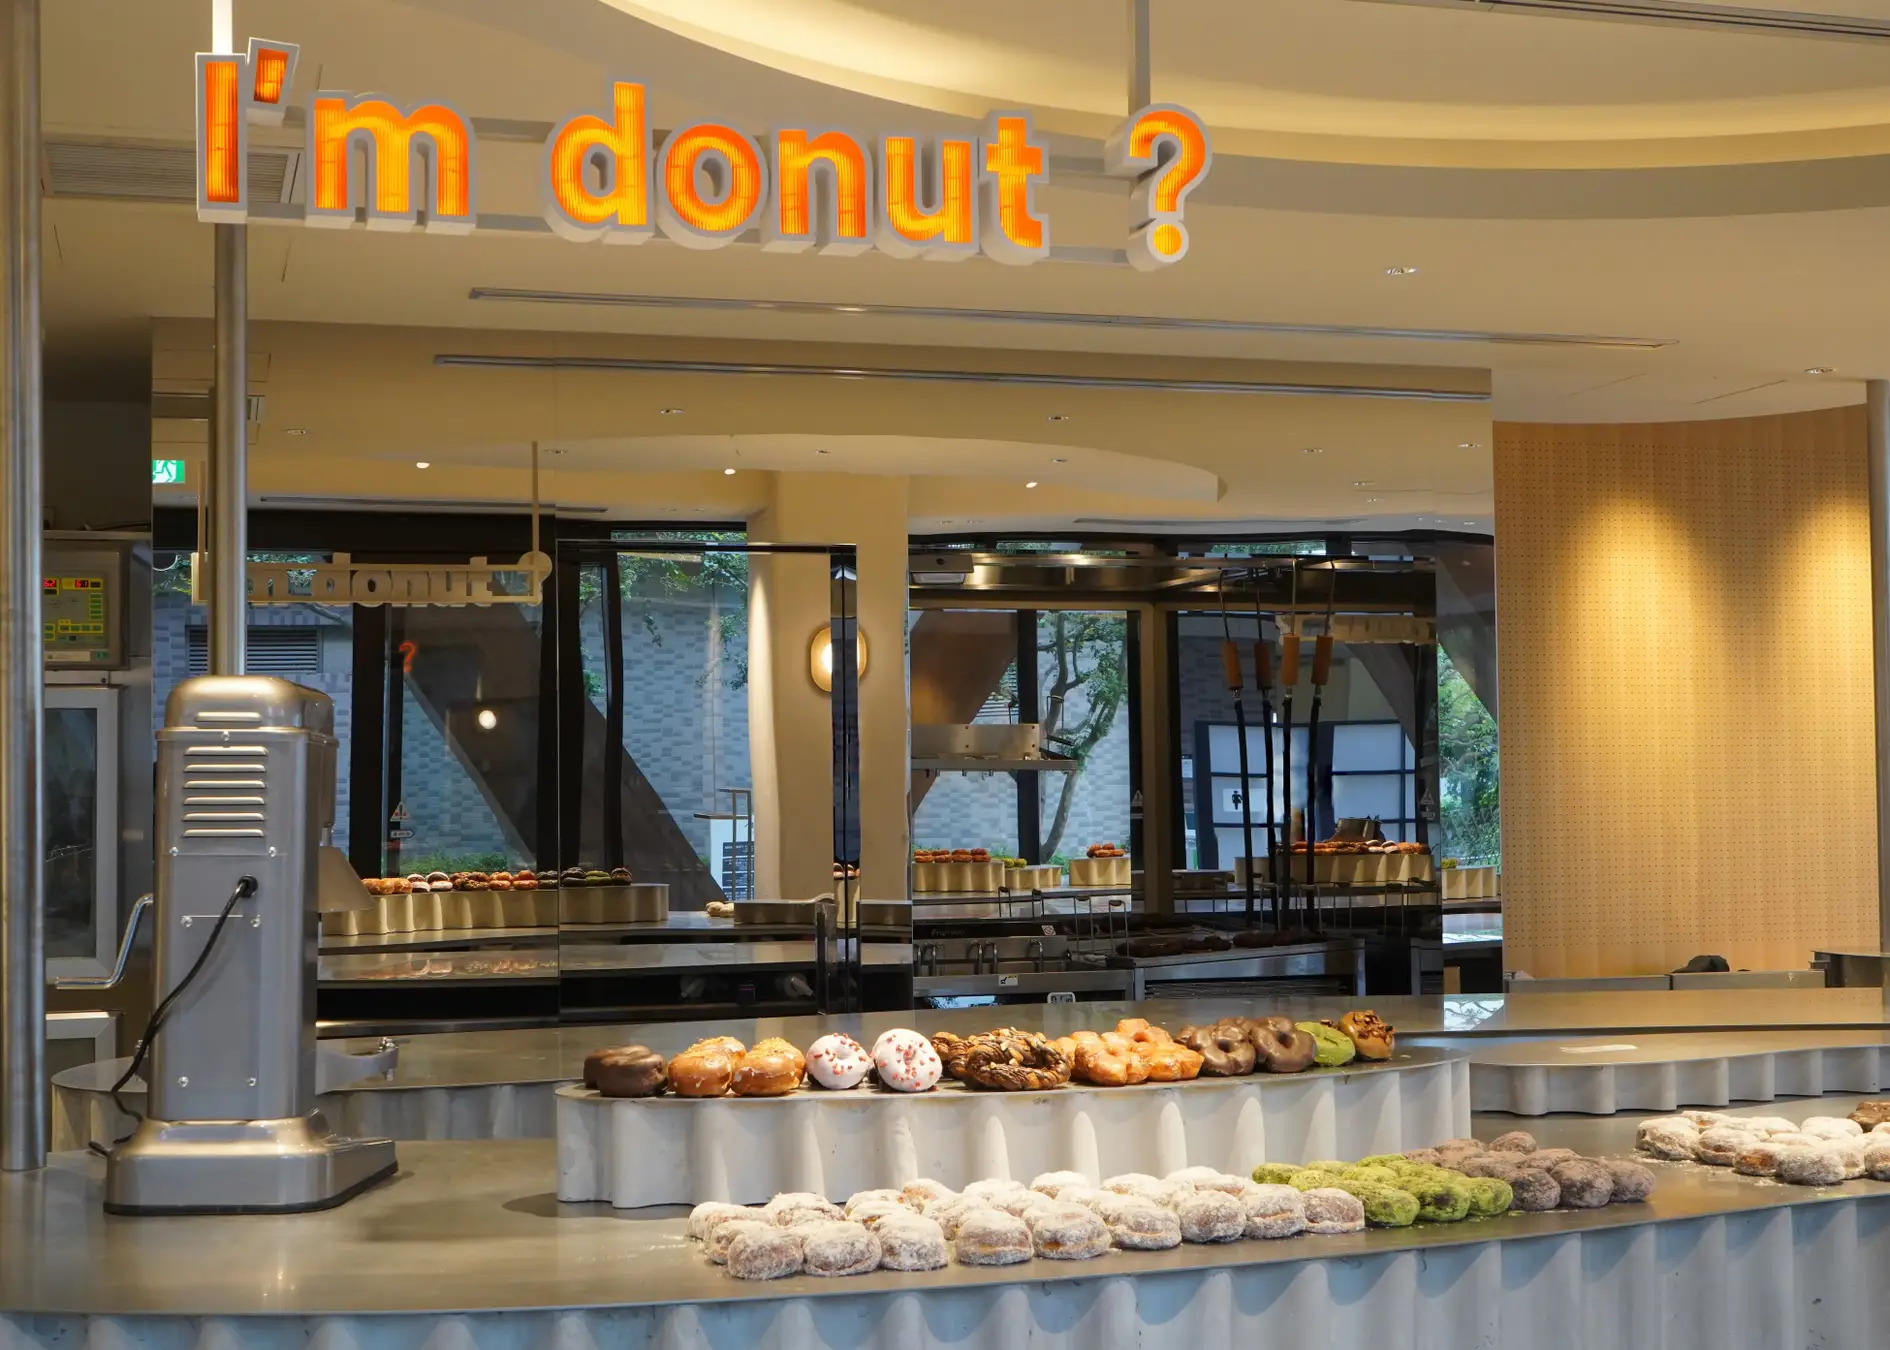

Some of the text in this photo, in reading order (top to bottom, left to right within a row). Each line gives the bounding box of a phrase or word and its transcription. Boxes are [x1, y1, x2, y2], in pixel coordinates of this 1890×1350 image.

[201, 45, 1208, 261] I'm donut ?
